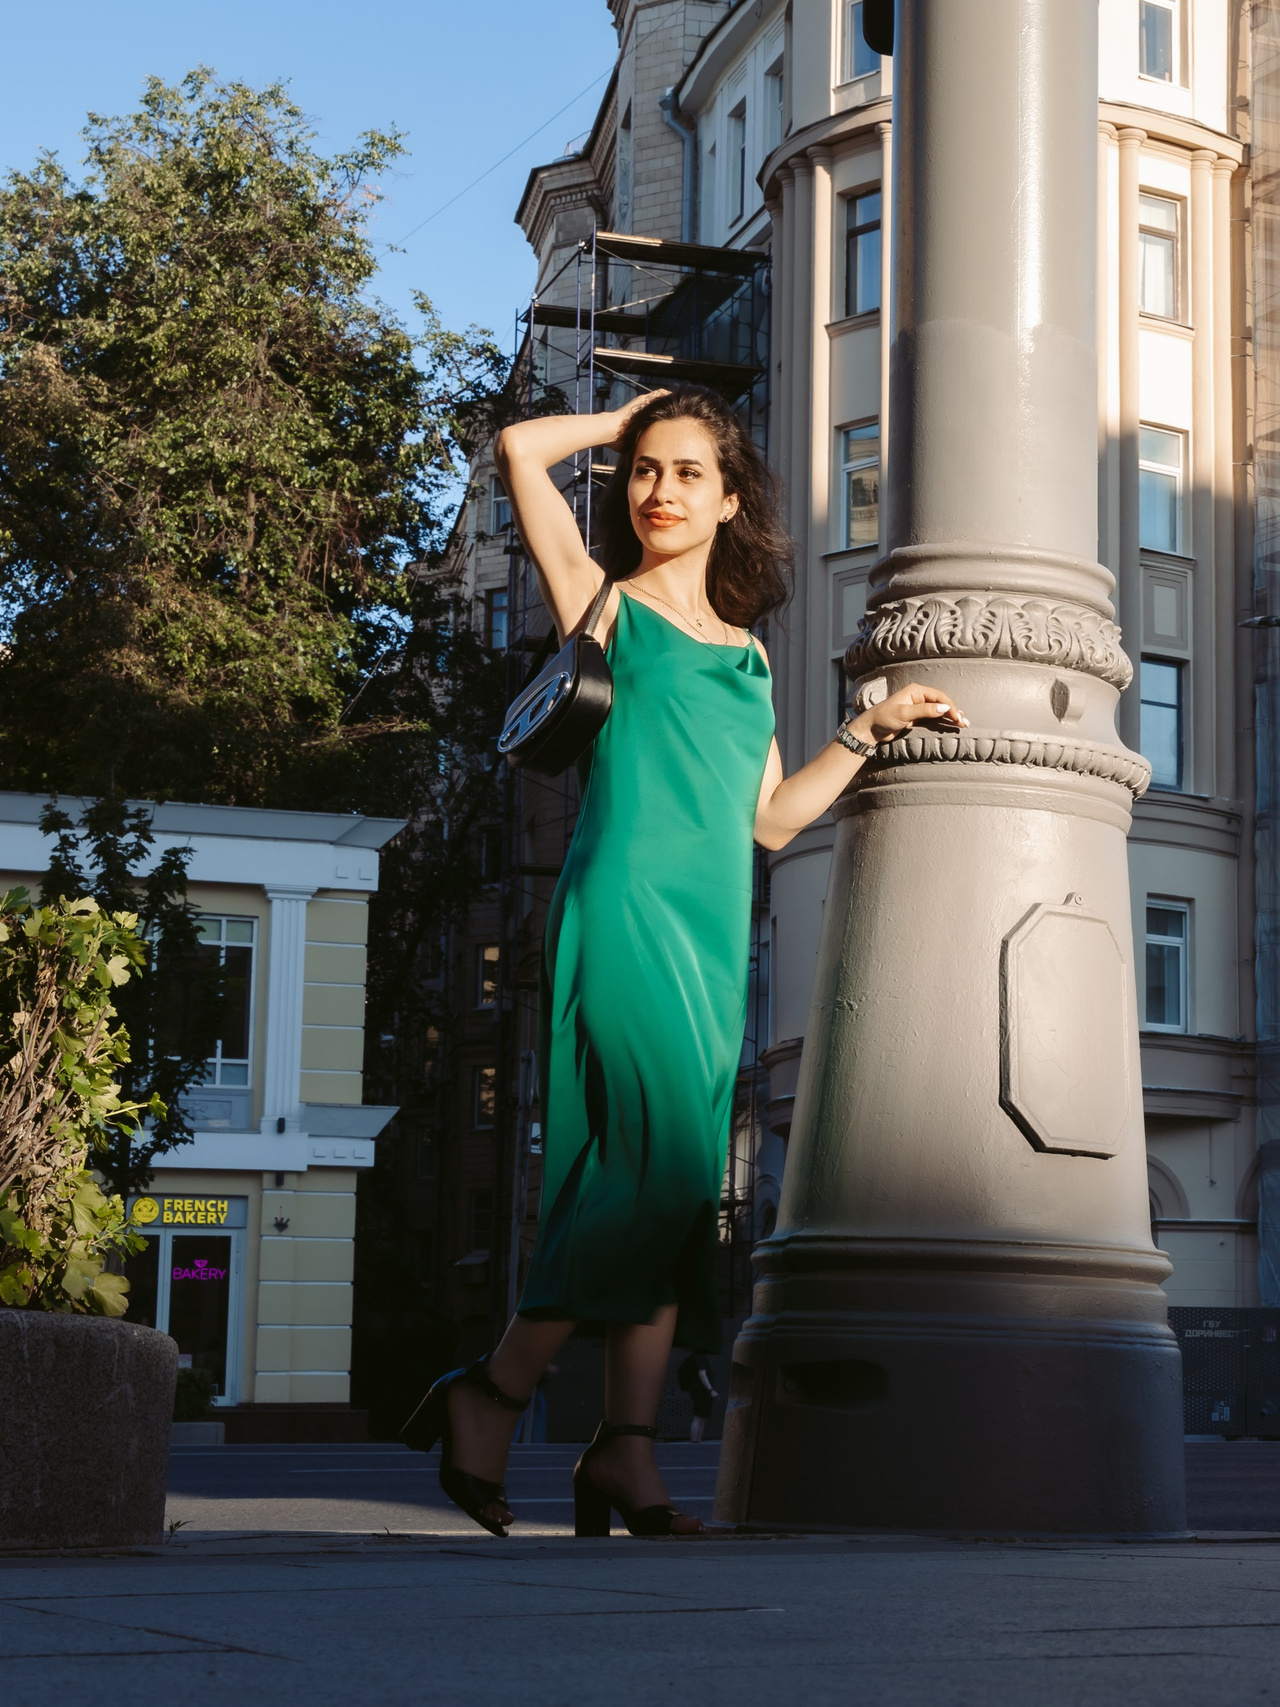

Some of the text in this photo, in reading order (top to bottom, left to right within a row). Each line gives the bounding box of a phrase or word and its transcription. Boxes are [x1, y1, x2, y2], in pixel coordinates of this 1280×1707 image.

[163, 1199, 228, 1213] FRENCH
[162, 1211, 228, 1224] BAKERY
[172, 1267, 227, 1280] BAKERY
[1203, 1320, 1222, 1328] ГБУ
